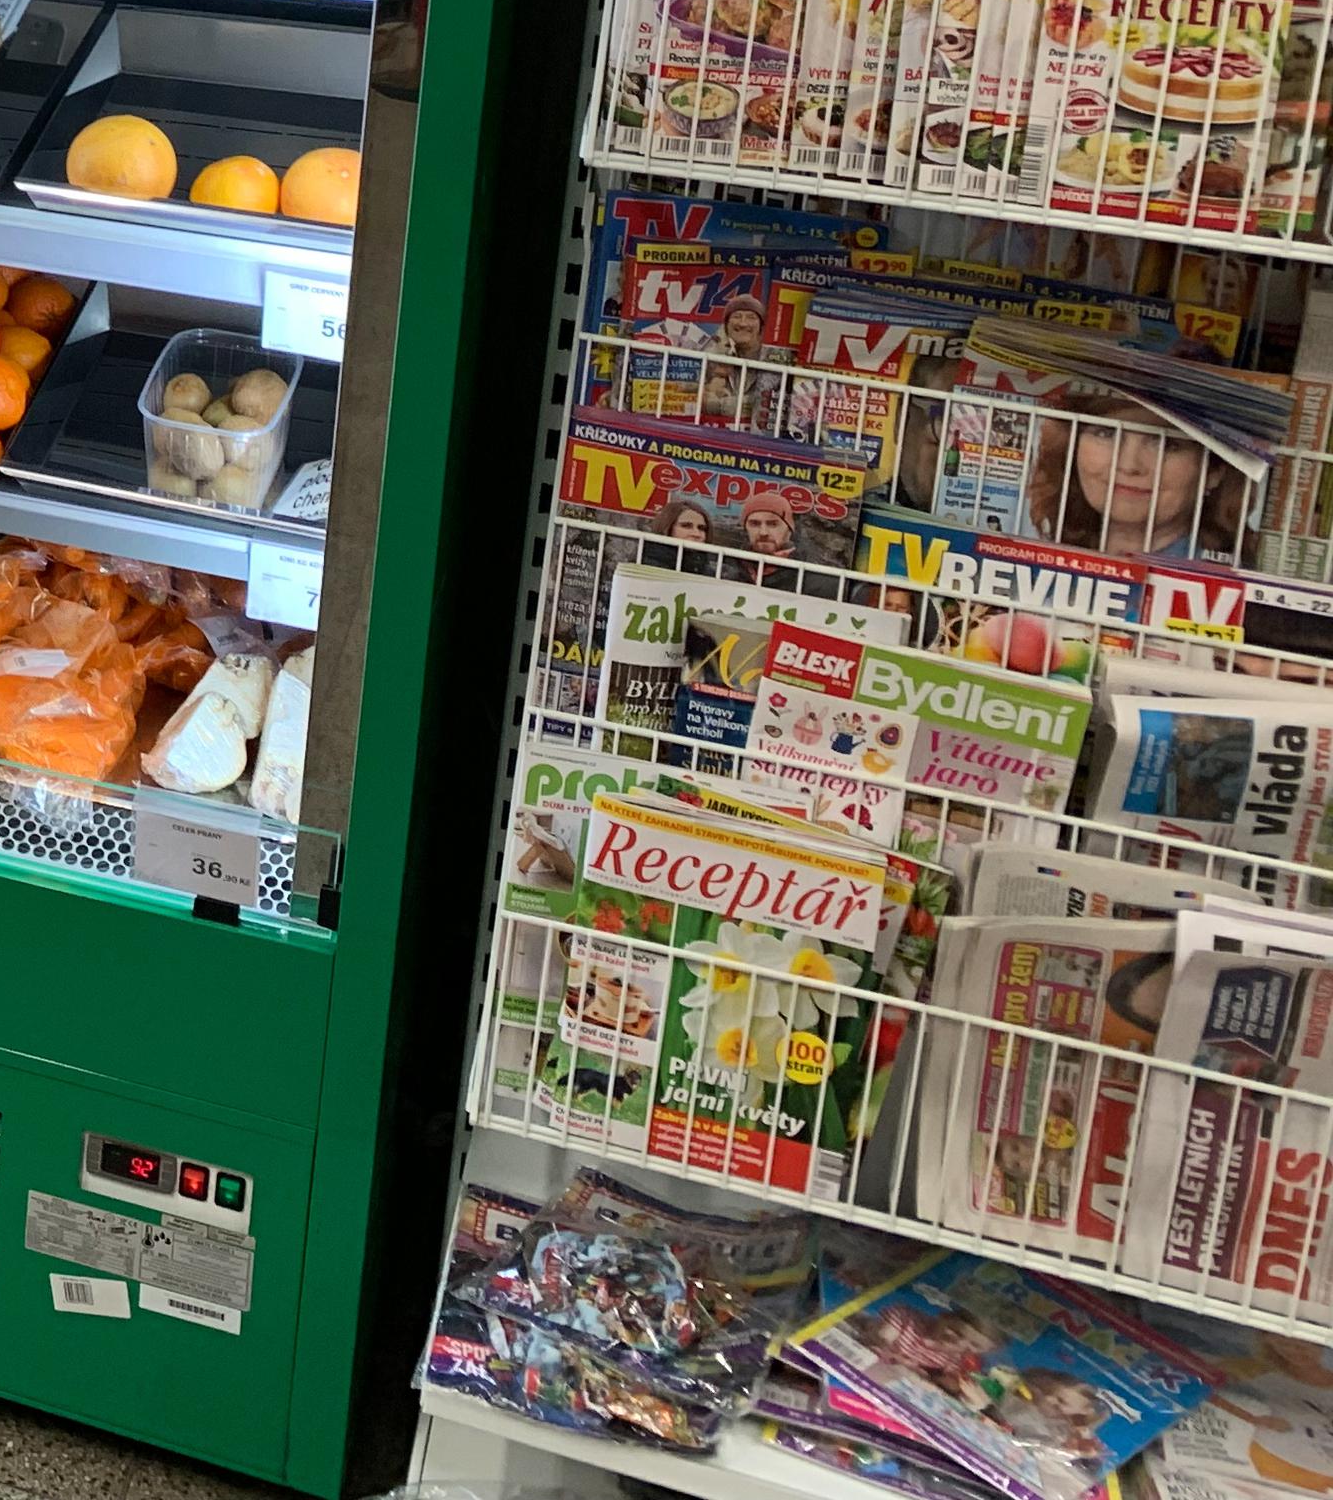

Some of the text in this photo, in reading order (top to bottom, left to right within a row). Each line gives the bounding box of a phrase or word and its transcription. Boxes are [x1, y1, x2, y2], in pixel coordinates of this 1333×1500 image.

[643, 250, 706, 263] PROGRAM
[661, 444, 738, 468] PROGRAM
[740, 456, 760, 471] NA
[763, 462, 781, 476] 14
[784, 462, 813, 482] DNÍ
[977, 540, 1035, 561] PROGRAM
[937, 552, 1132, 623] REVUE
[688, 699, 736, 720] Přípravy
[774, 641, 1076, 746] BLESK Bydlení
[913, 760, 1000, 798] jaro
[928, 729, 1056, 783] Vítáme
[1244, 724, 1309, 836] vláda
[644, 814, 694, 835] ZAHRADNÍ
[588, 820, 873, 931] Receptář
[1166, 1206, 1197, 1264] TEST
